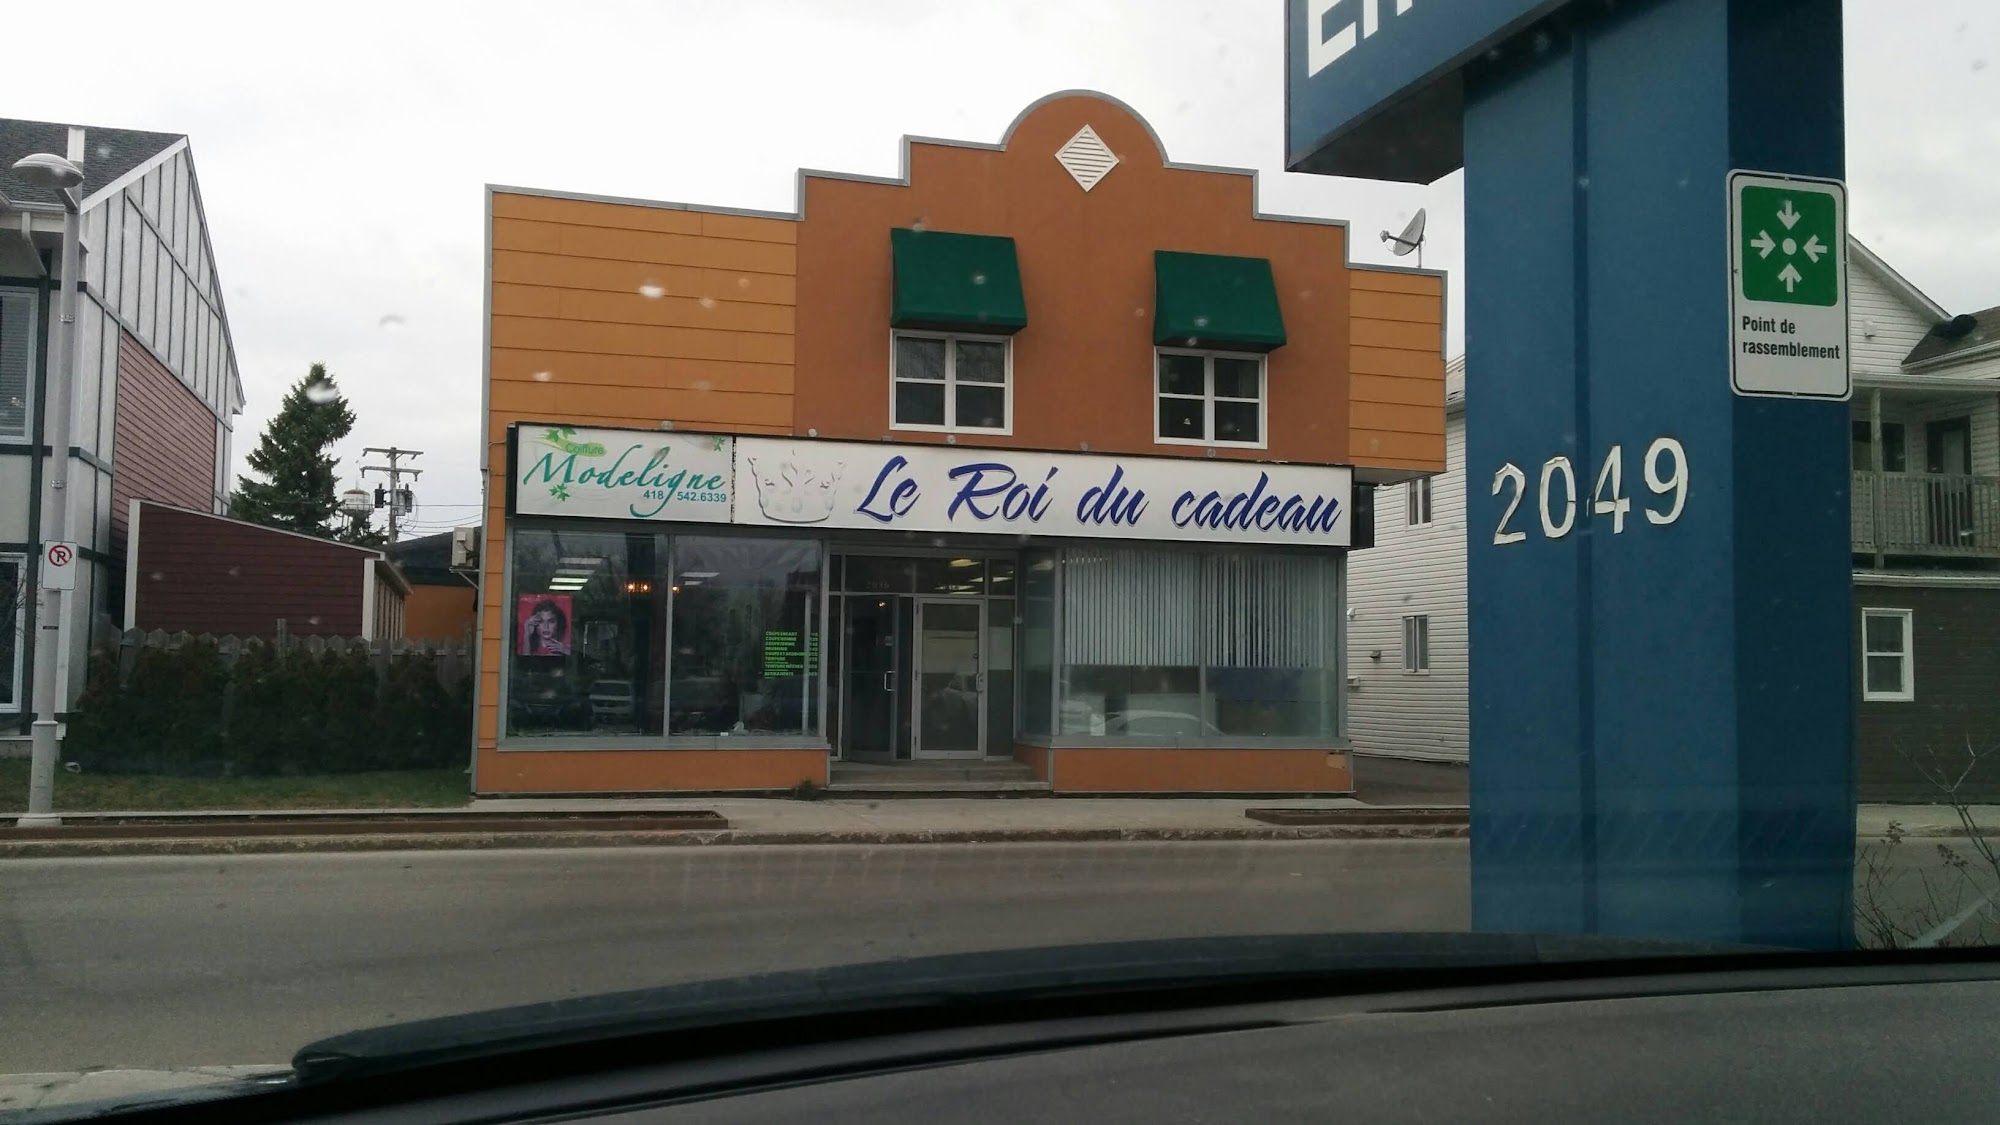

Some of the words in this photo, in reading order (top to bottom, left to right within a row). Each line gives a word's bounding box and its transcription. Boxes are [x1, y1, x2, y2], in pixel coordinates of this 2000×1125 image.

[1742, 315, 1776, 333] Point
[1780, 318, 1796, 335] de
[1742, 341, 1840, 359] rassemblement
[523, 444, 726, 518] Modeligne
[643, 489, 664, 500] 418
[677, 491, 727, 503] 542.6339
[857, 455, 921, 522] Le
[948, 463, 1059, 523] Roi
[1076, 464, 1149, 527] du
[1171, 471, 1342, 535] cadeau
[1492, 437, 1688, 545] 2049
